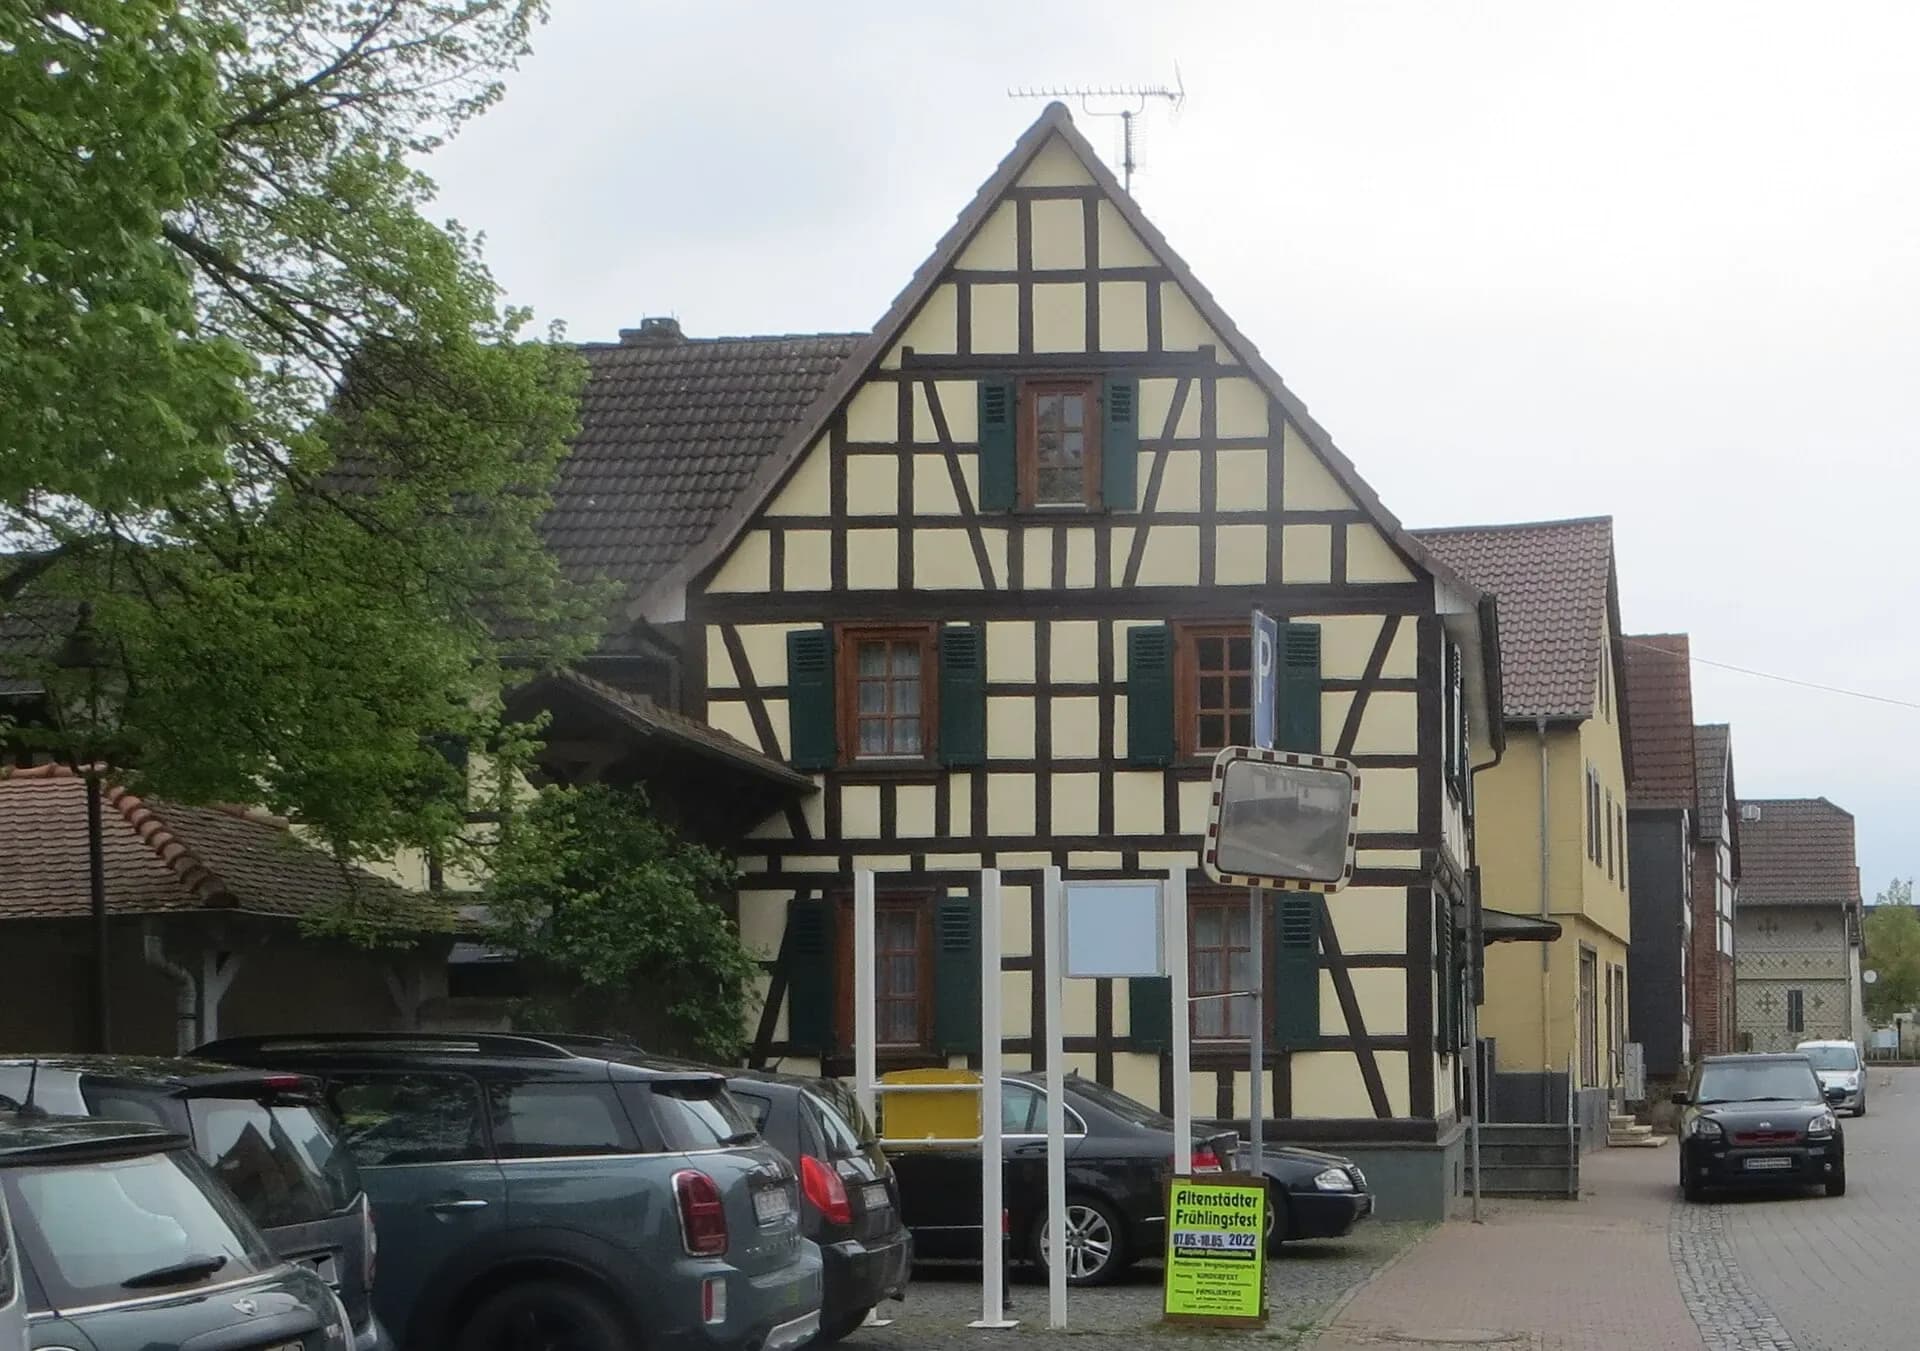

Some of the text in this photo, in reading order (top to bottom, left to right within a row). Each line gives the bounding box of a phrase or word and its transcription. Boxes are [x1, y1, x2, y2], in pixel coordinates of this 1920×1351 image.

[1258, 628, 1271, 704] P
[1177, 1190, 1258, 1208] Altenstädter
[1176, 1209, 1257, 1229] Frühlingsfest
[1229, 1233, 1256, 1247] 2022
